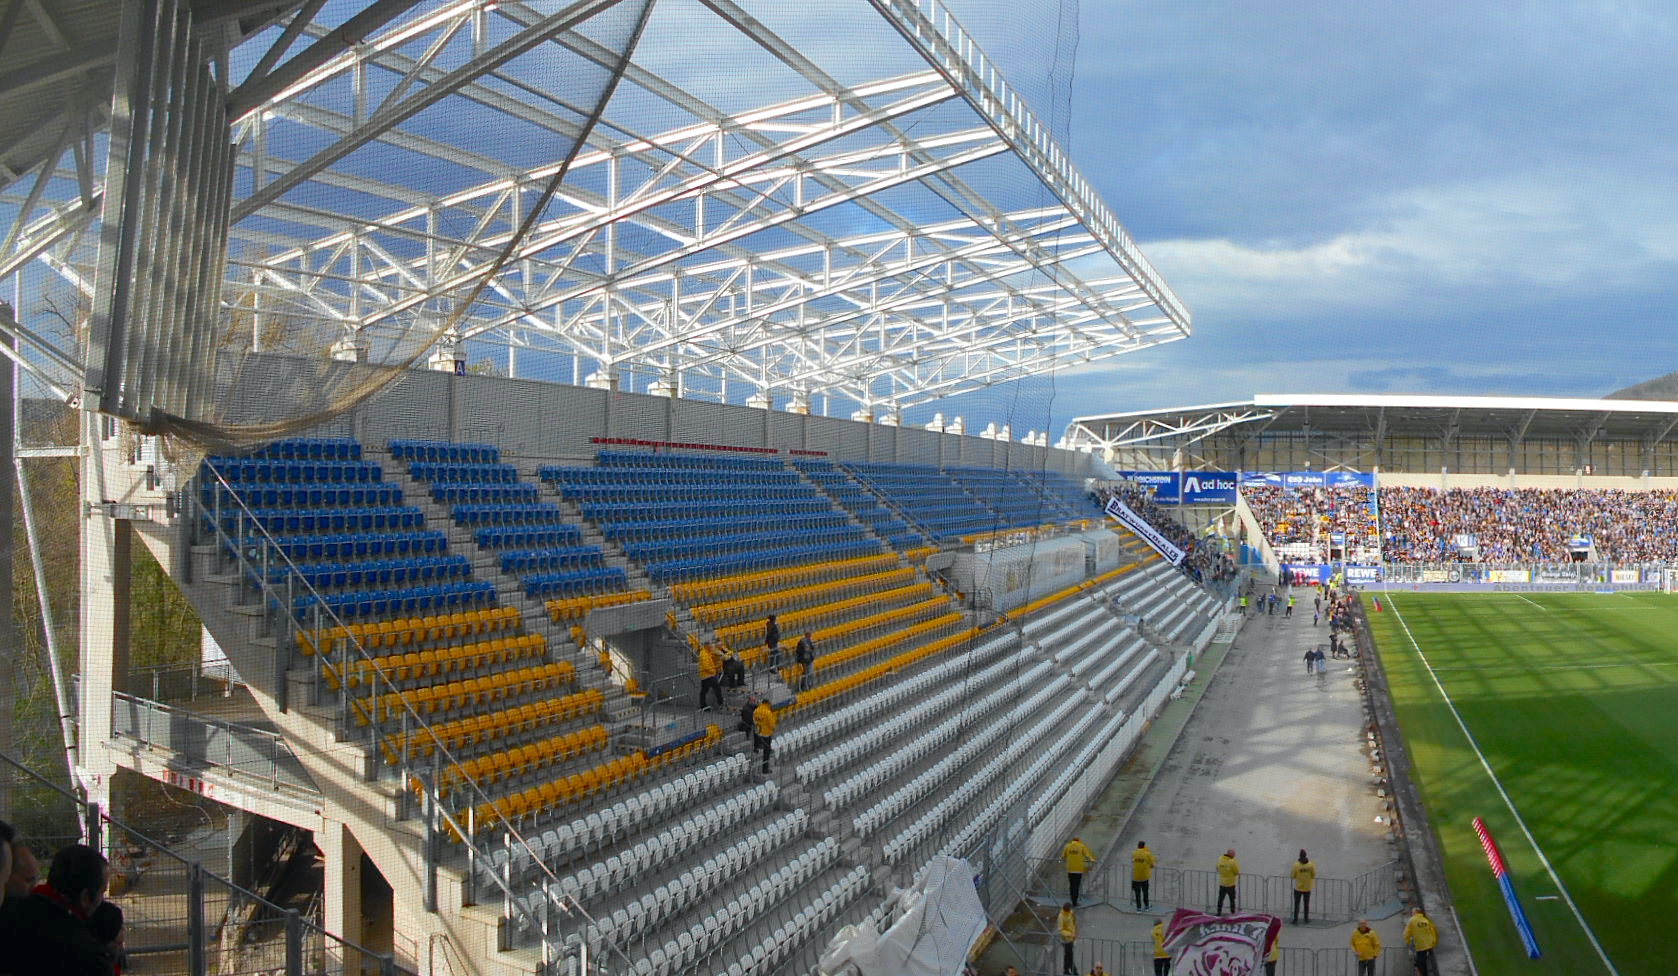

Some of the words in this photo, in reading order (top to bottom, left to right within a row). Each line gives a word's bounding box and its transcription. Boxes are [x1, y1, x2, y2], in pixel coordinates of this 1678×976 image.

[1201, 479, 1214, 490] ad
[1216, 479, 1234, 490] hoc
[1347, 568, 1377, 578] REWE
[1493, 583, 1568, 592] Abenteuer
